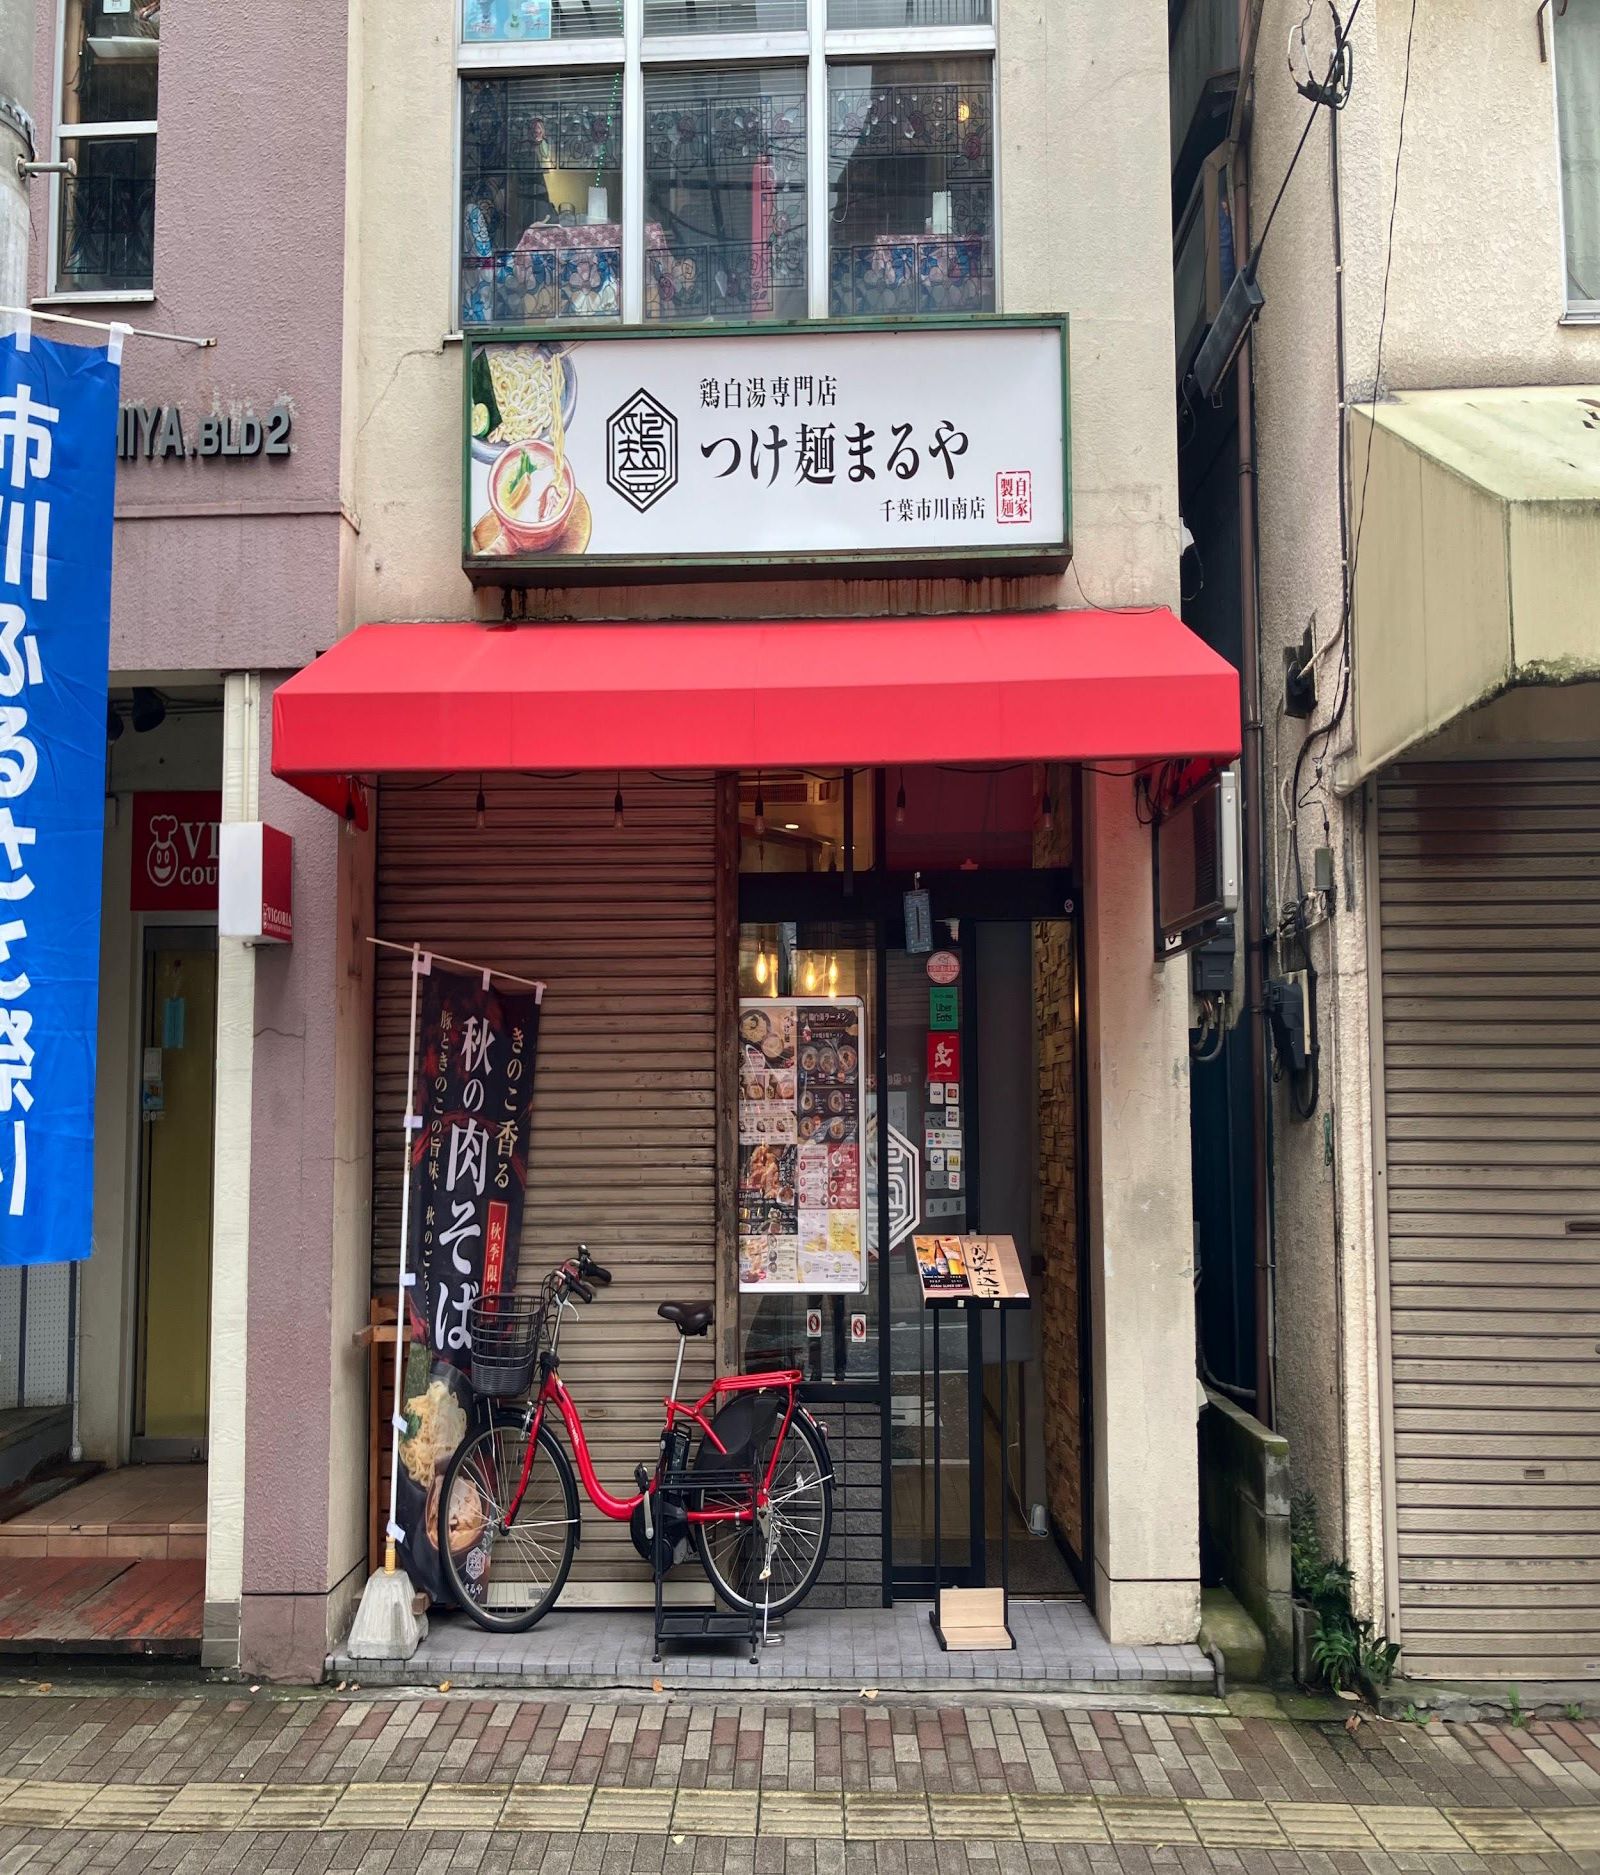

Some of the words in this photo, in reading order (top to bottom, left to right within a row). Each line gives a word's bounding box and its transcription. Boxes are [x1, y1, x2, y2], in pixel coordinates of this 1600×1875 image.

[700, 375, 837, 409] 鶏白湯専門店
[700, 420, 969, 489] つけ麺まるや
[879, 496, 985, 522] 千葉市川南店
[936, 1003, 953, 1012] Uber
[936, 1014, 953, 1022] Eats
[494, 1027, 524, 1189] きのこ香る
[436, 1015, 496, 1350] 秋の肉そば
